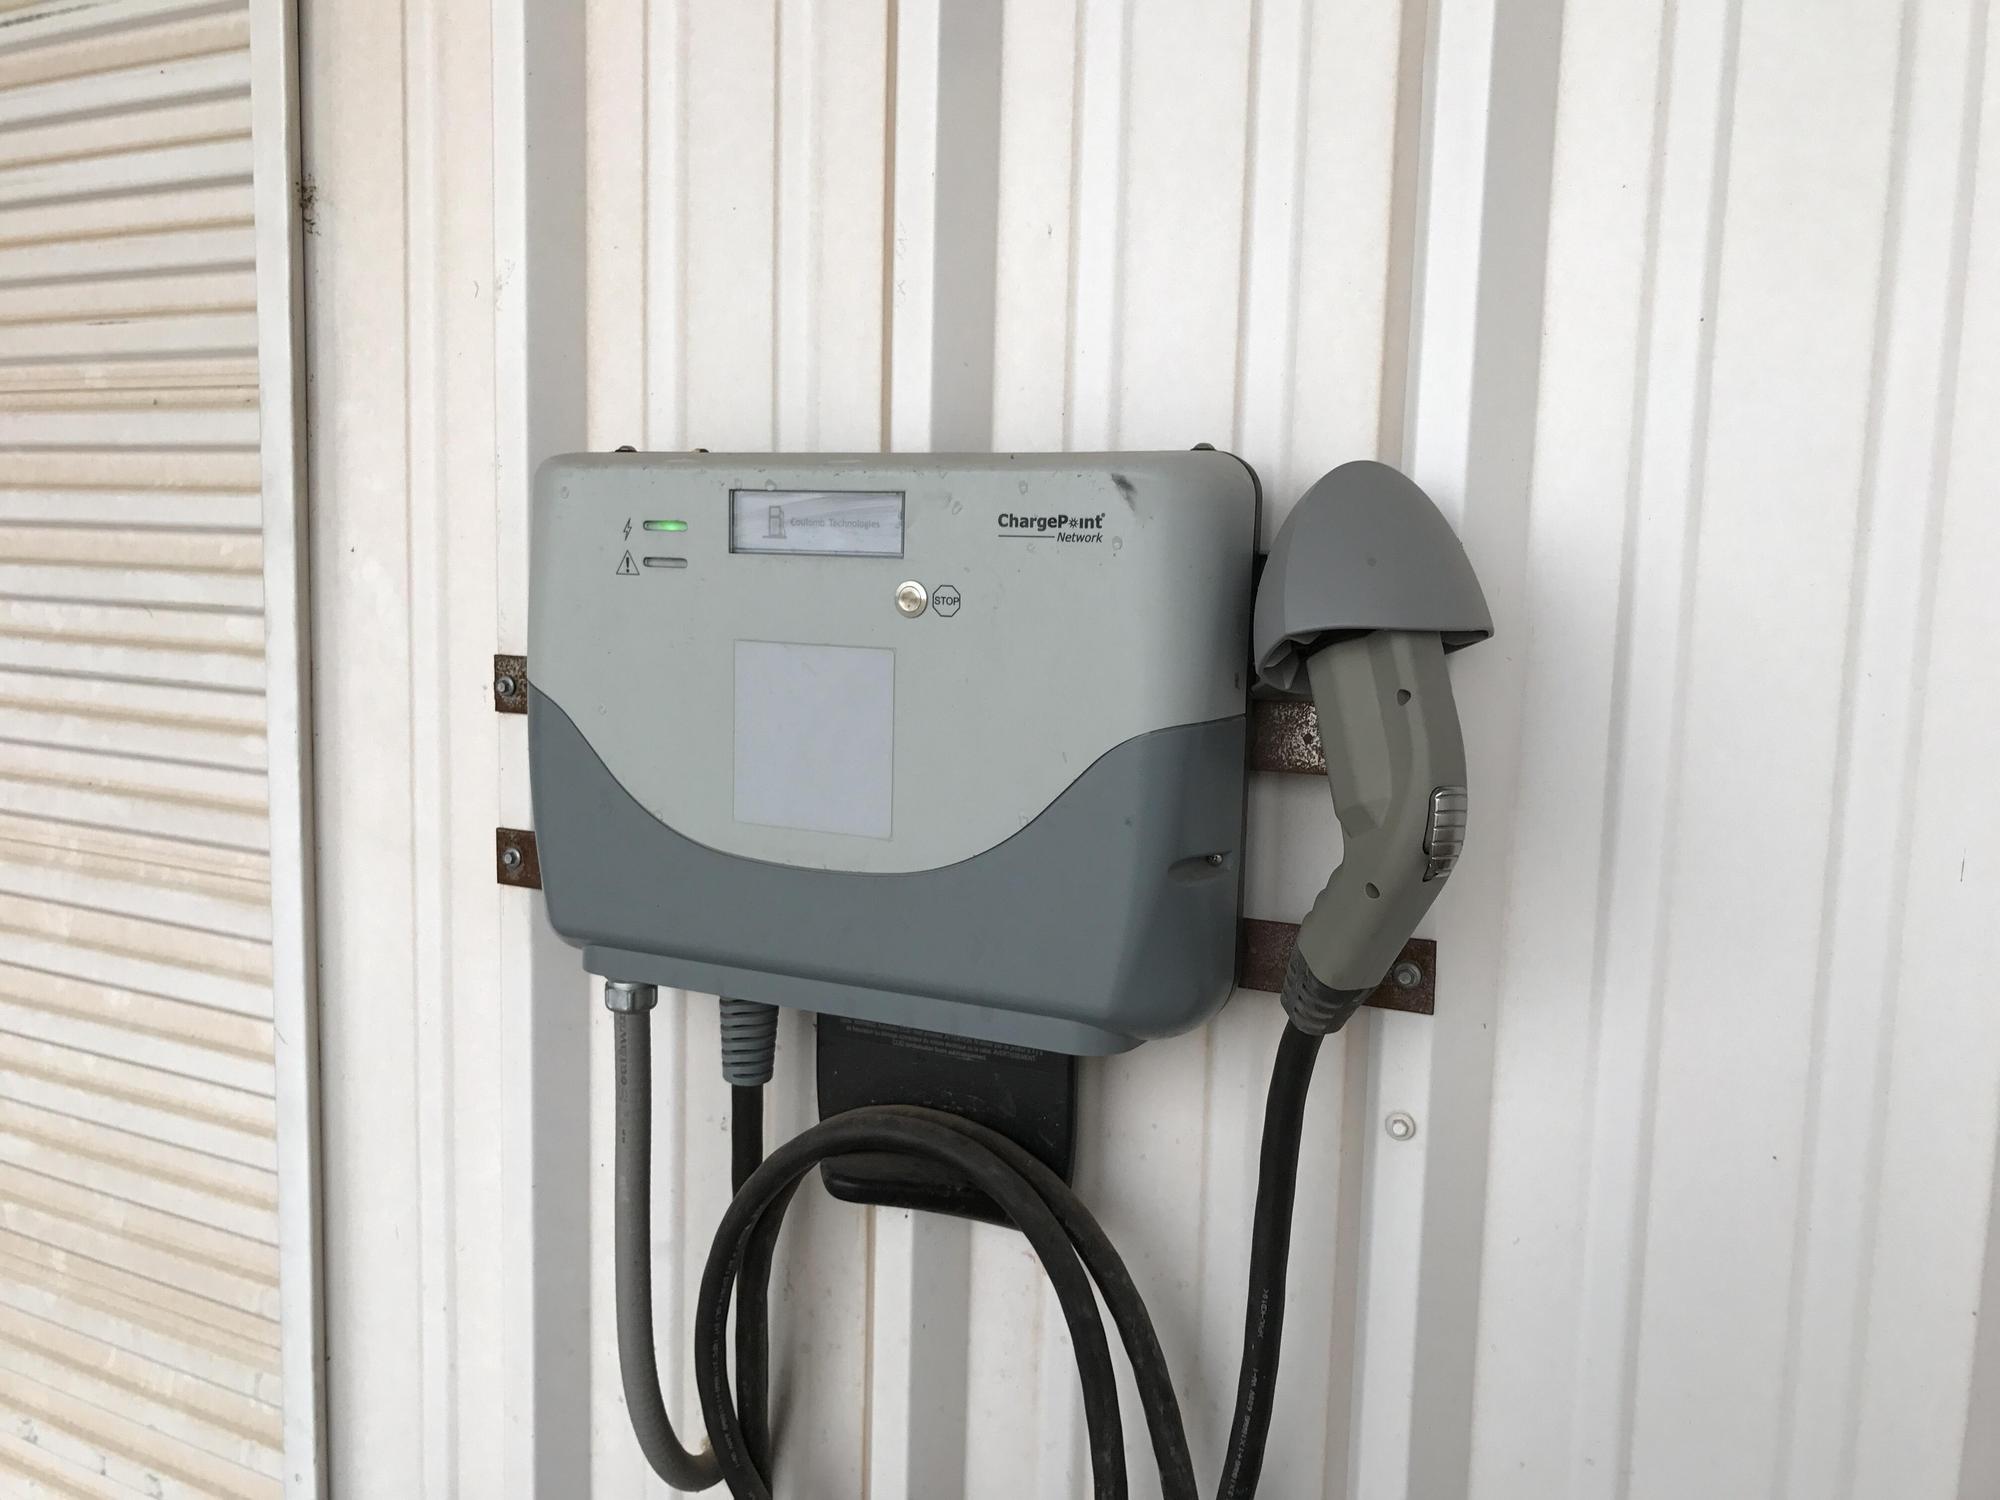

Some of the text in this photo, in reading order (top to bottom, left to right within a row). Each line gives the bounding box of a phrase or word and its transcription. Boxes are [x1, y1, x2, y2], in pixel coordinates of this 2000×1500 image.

[829, 518, 881, 530] Technologies
[1056, 532, 1104, 543] Network
[934, 595, 960, 606] STOP
